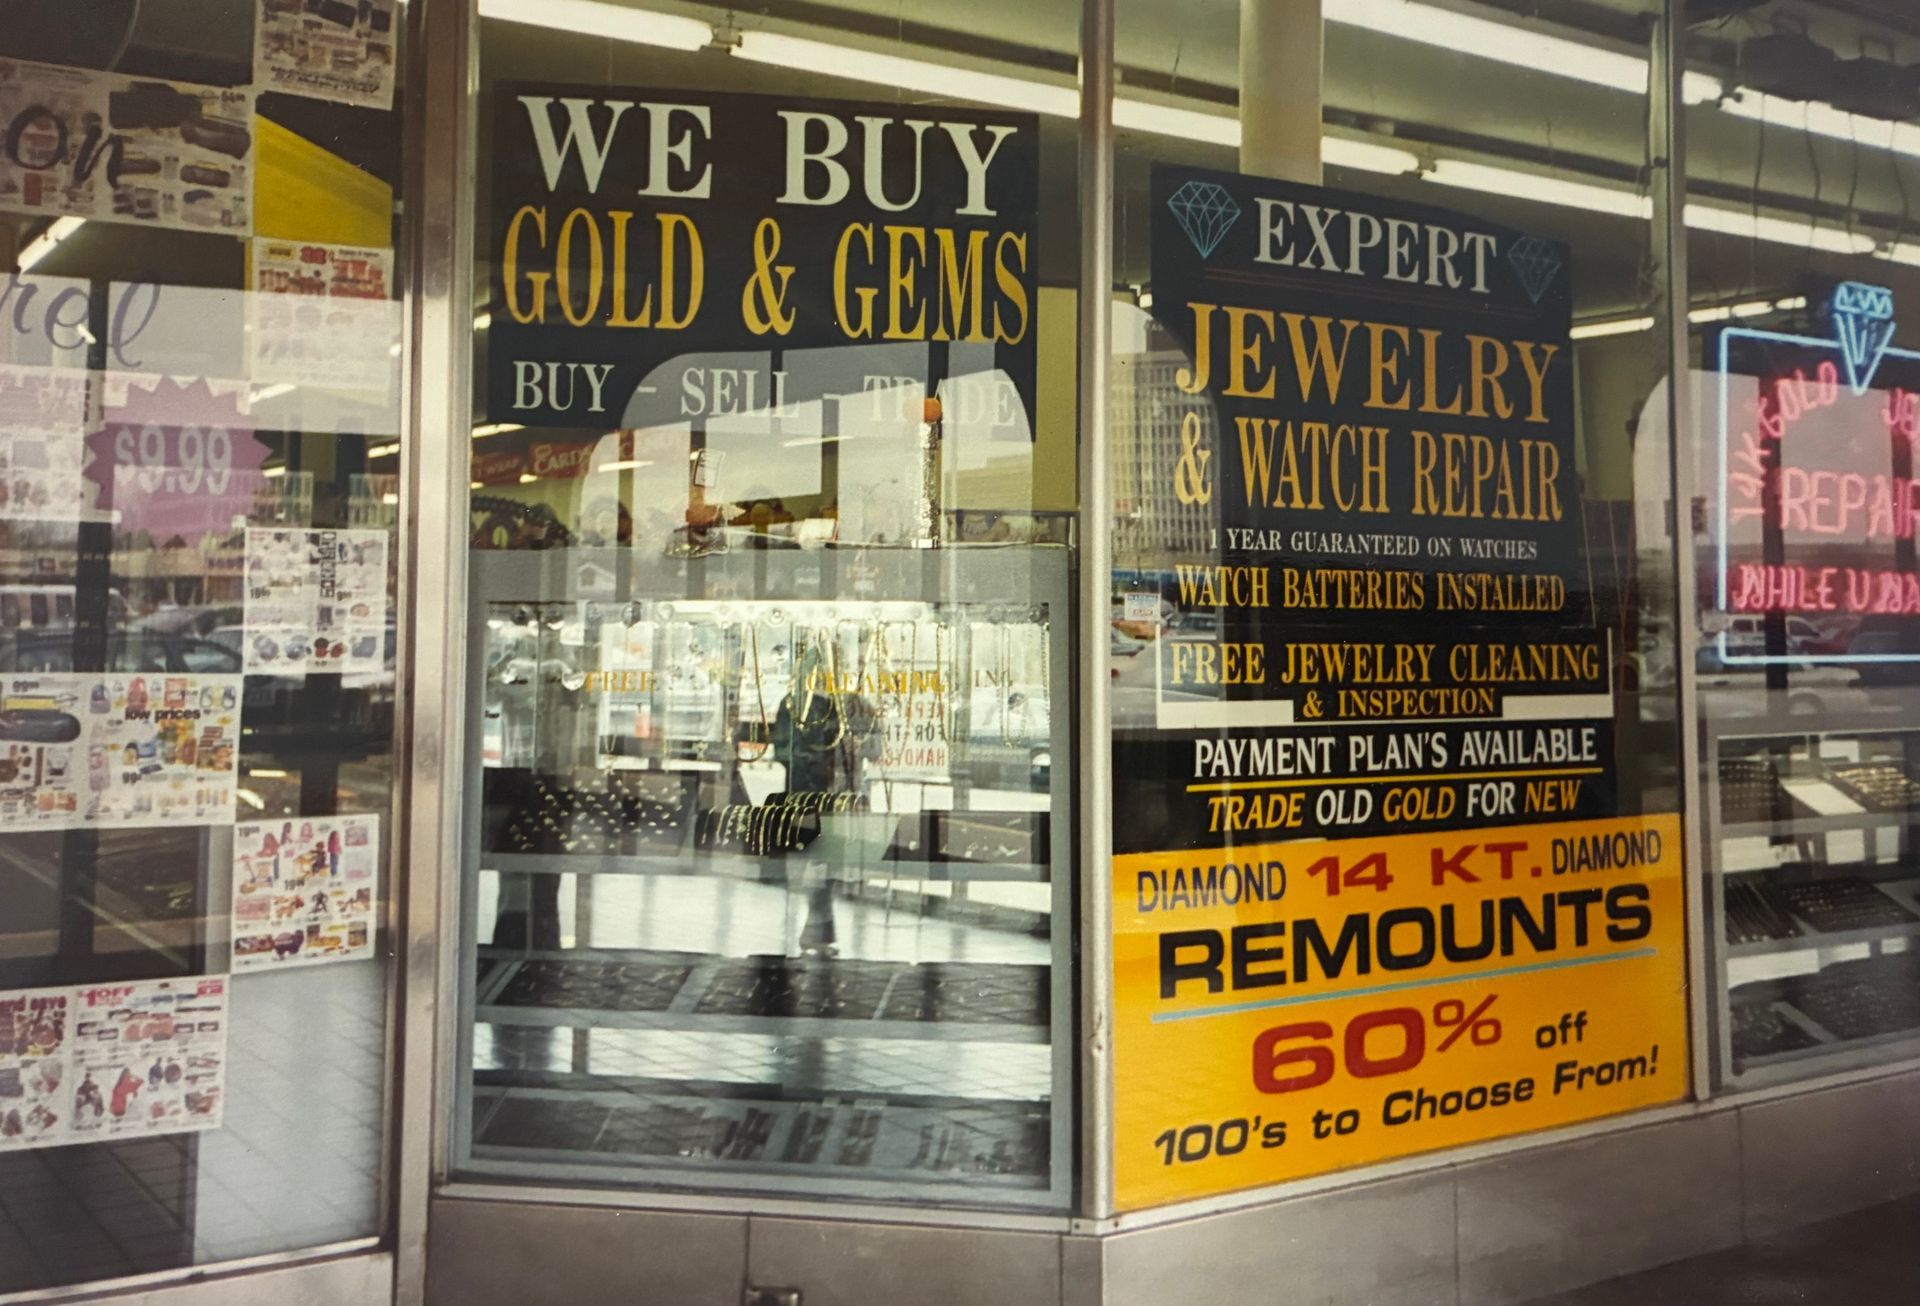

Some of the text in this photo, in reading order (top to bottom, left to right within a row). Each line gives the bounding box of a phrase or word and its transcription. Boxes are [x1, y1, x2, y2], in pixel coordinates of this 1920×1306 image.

[517, 96, 1018, 216] WE BUY
[503, 205, 1028, 345] GOLD & GEMS
[1253, 197, 1497, 293] EXPERT
[512, 360, 615, 412] BUY
[680, 367, 800, 419] SELL
[1175, 302, 1559, 423] JEWELRY
[1758, 361, 1838, 440] GOLD
[1174, 411, 1563, 521] & WATCH REPAIR
[1209, 528, 1538, 561] 1 YEAR GUARANTEED ON WATCHES
[1175, 564, 1565, 612] WATCH BATTERIES INSTALLED
[1731, 564, 1838, 610] WHILE
[1846, 568, 1870, 611] U
[1170, 643, 1599, 685] FREE JEWELRY CLEANING
[1302, 688, 1495, 718] & INSPECTION
[1195, 727, 1597, 778] PAYMENT PLAN'S AVAILABLE
[1207, 780, 1582, 833] TRADE OLD GOLD FOR NEW
[1136, 829, 1661, 913] DIAMOND 14 KT. DIAMOND
[1158, 882, 1653, 1000] REMOUNTS
[1251, 993, 1588, 1095] 60% off
[1153, 1044, 1660, 1166] 100's to Choose From!
